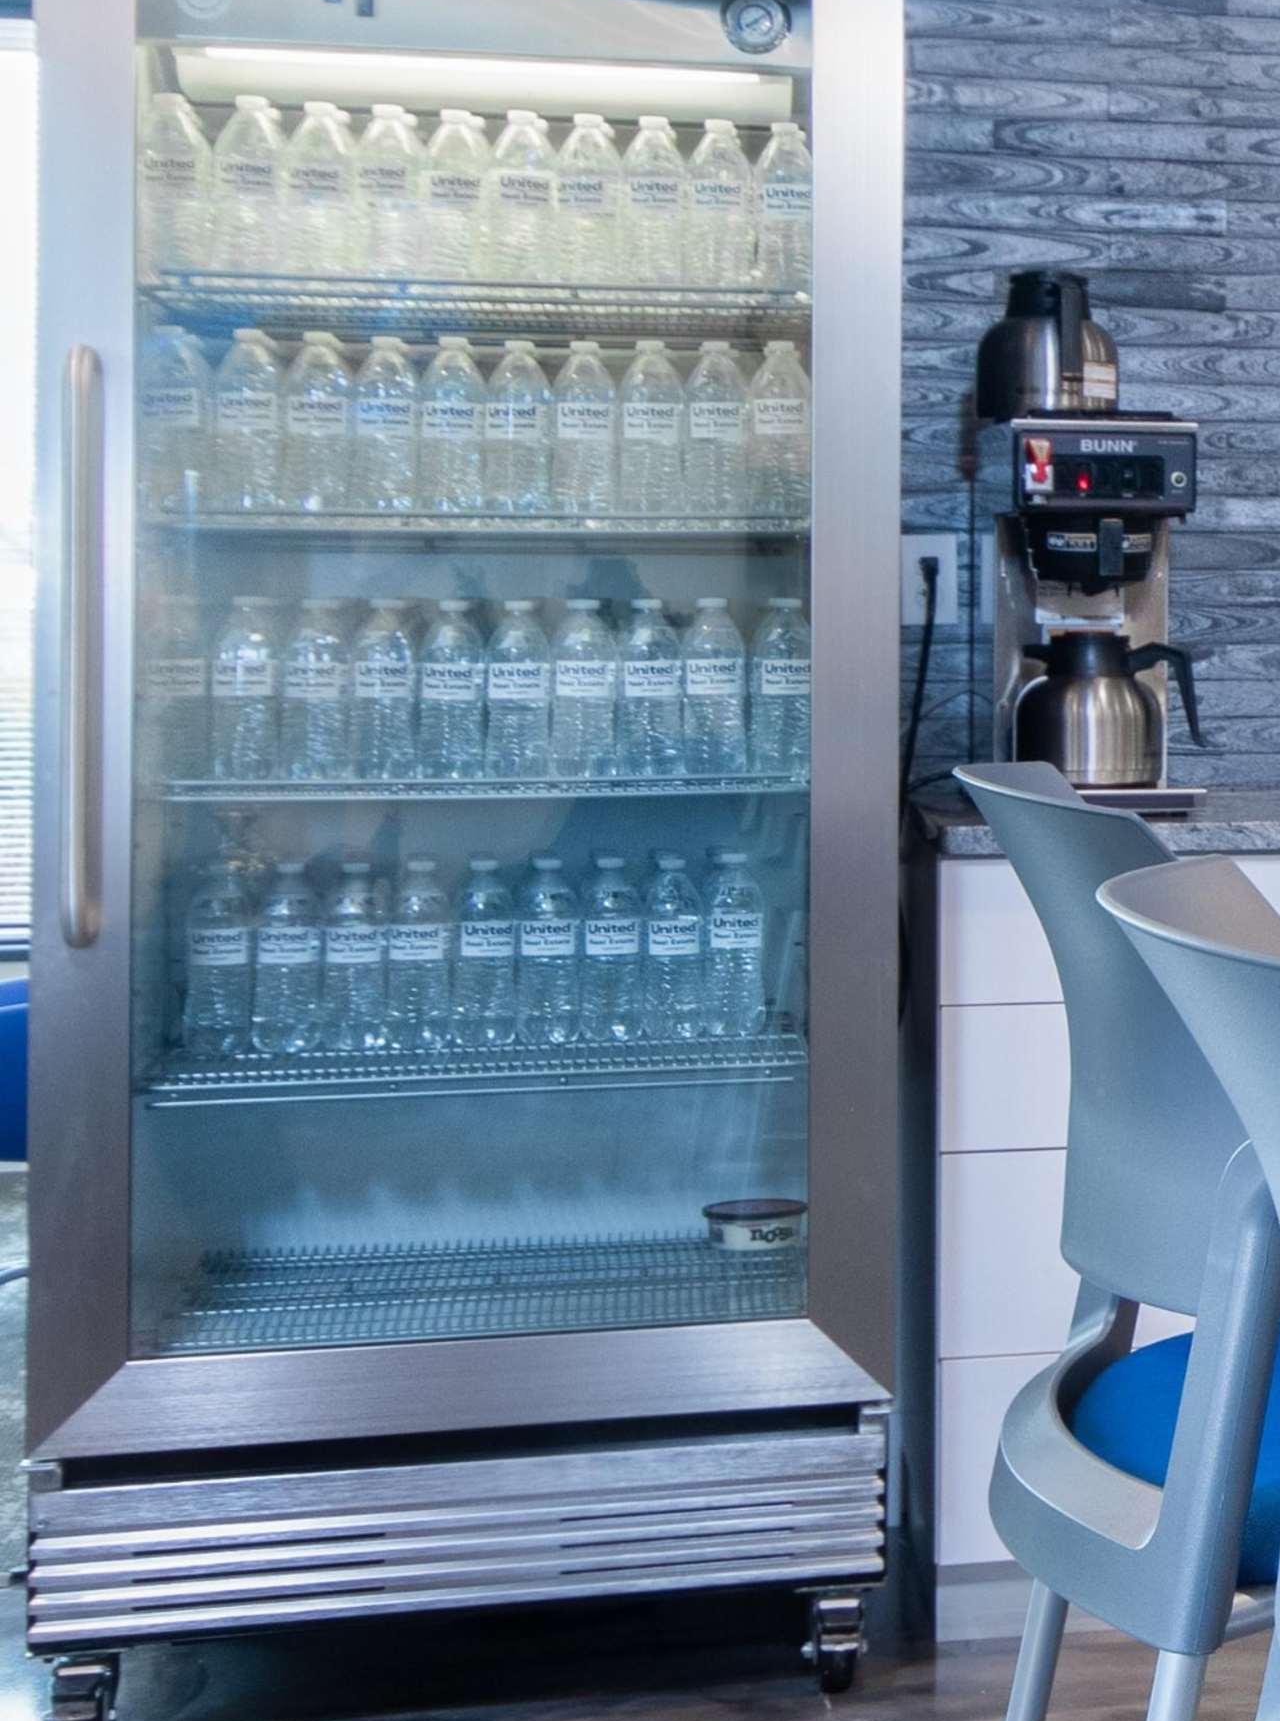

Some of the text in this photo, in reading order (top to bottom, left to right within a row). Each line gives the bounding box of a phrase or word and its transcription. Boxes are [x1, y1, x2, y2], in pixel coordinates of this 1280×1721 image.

[1081, 439, 1133, 453] BUNN
[464, 924, 512, 936] United
[523, 924, 571, 935] United
[588, 924, 636, 935] United
[650, 924, 697, 935] United
